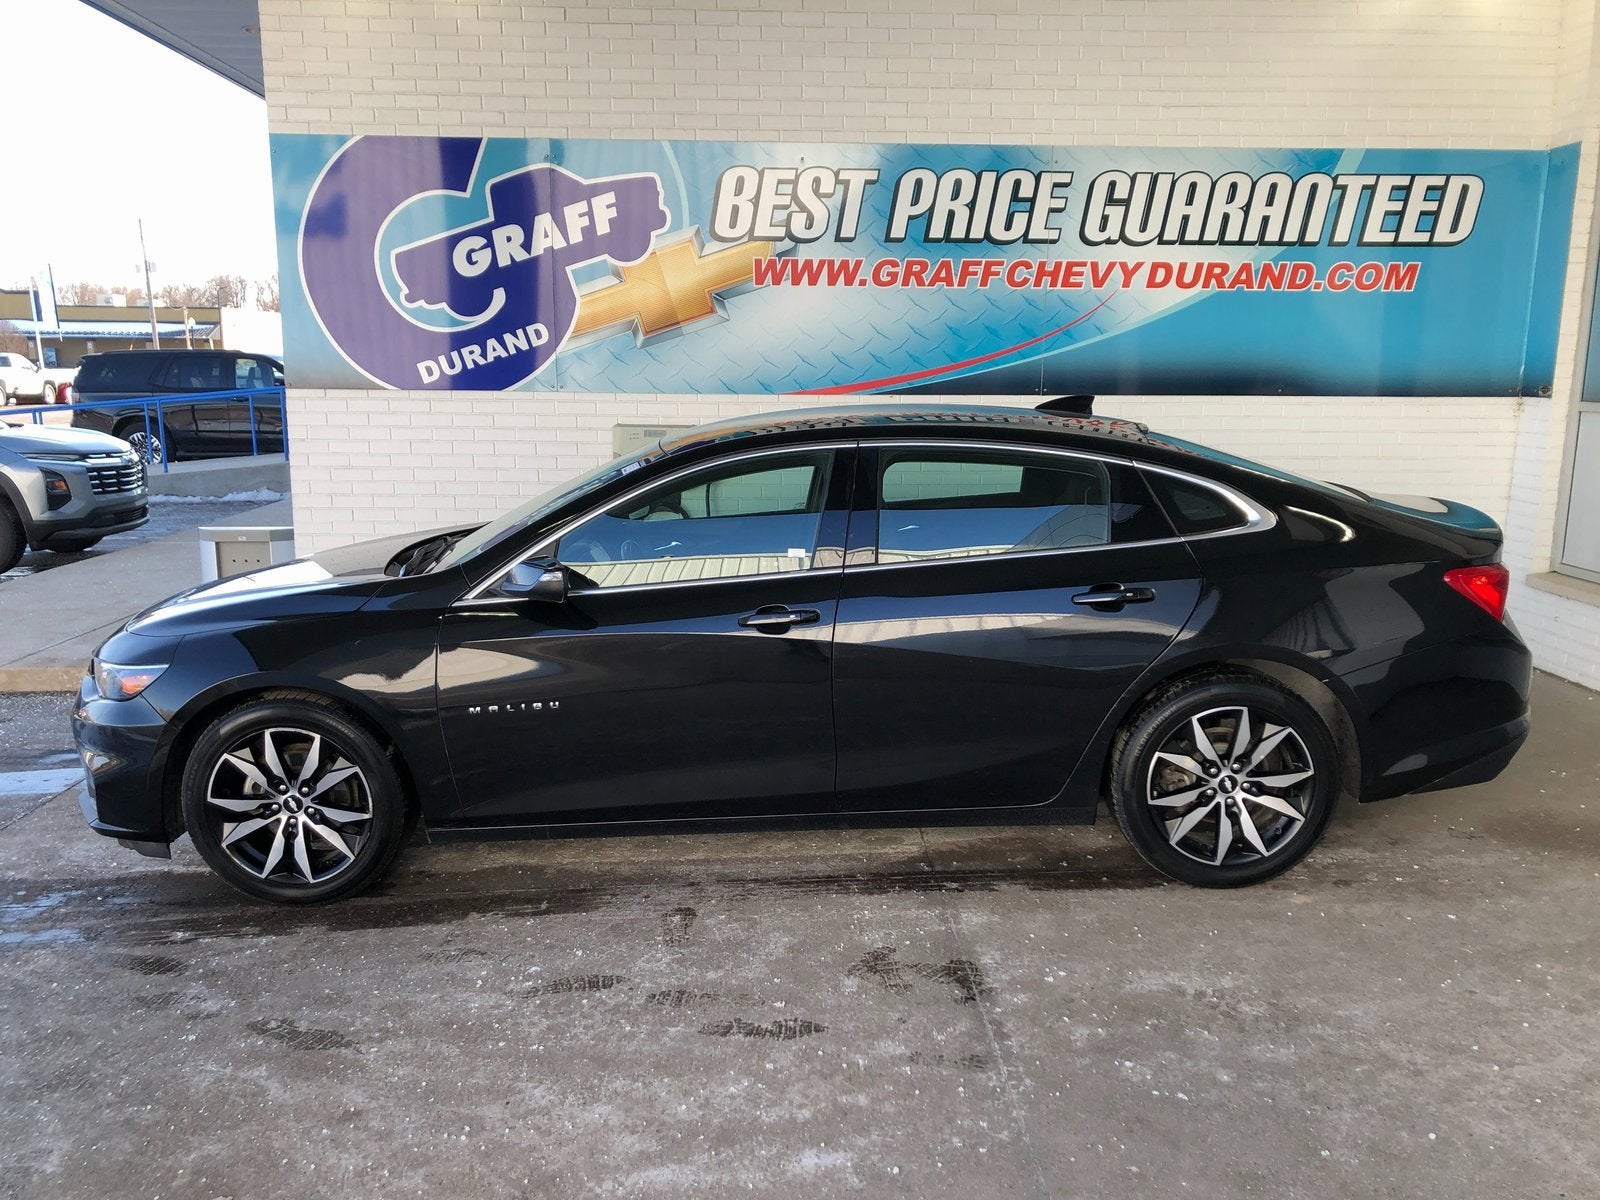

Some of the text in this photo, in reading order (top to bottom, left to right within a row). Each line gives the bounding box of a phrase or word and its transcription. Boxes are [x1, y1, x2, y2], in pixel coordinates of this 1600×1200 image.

[452, 191, 618, 278] GRAFF
[709, 164, 1485, 247] BEST PRICE GUARANTEED
[752, 256, 1422, 293] WWW.GRAFFCHEVYDURAND.COM
[416, 322, 550, 385] DURAND
[468, 701, 560, 714] MALIBU
